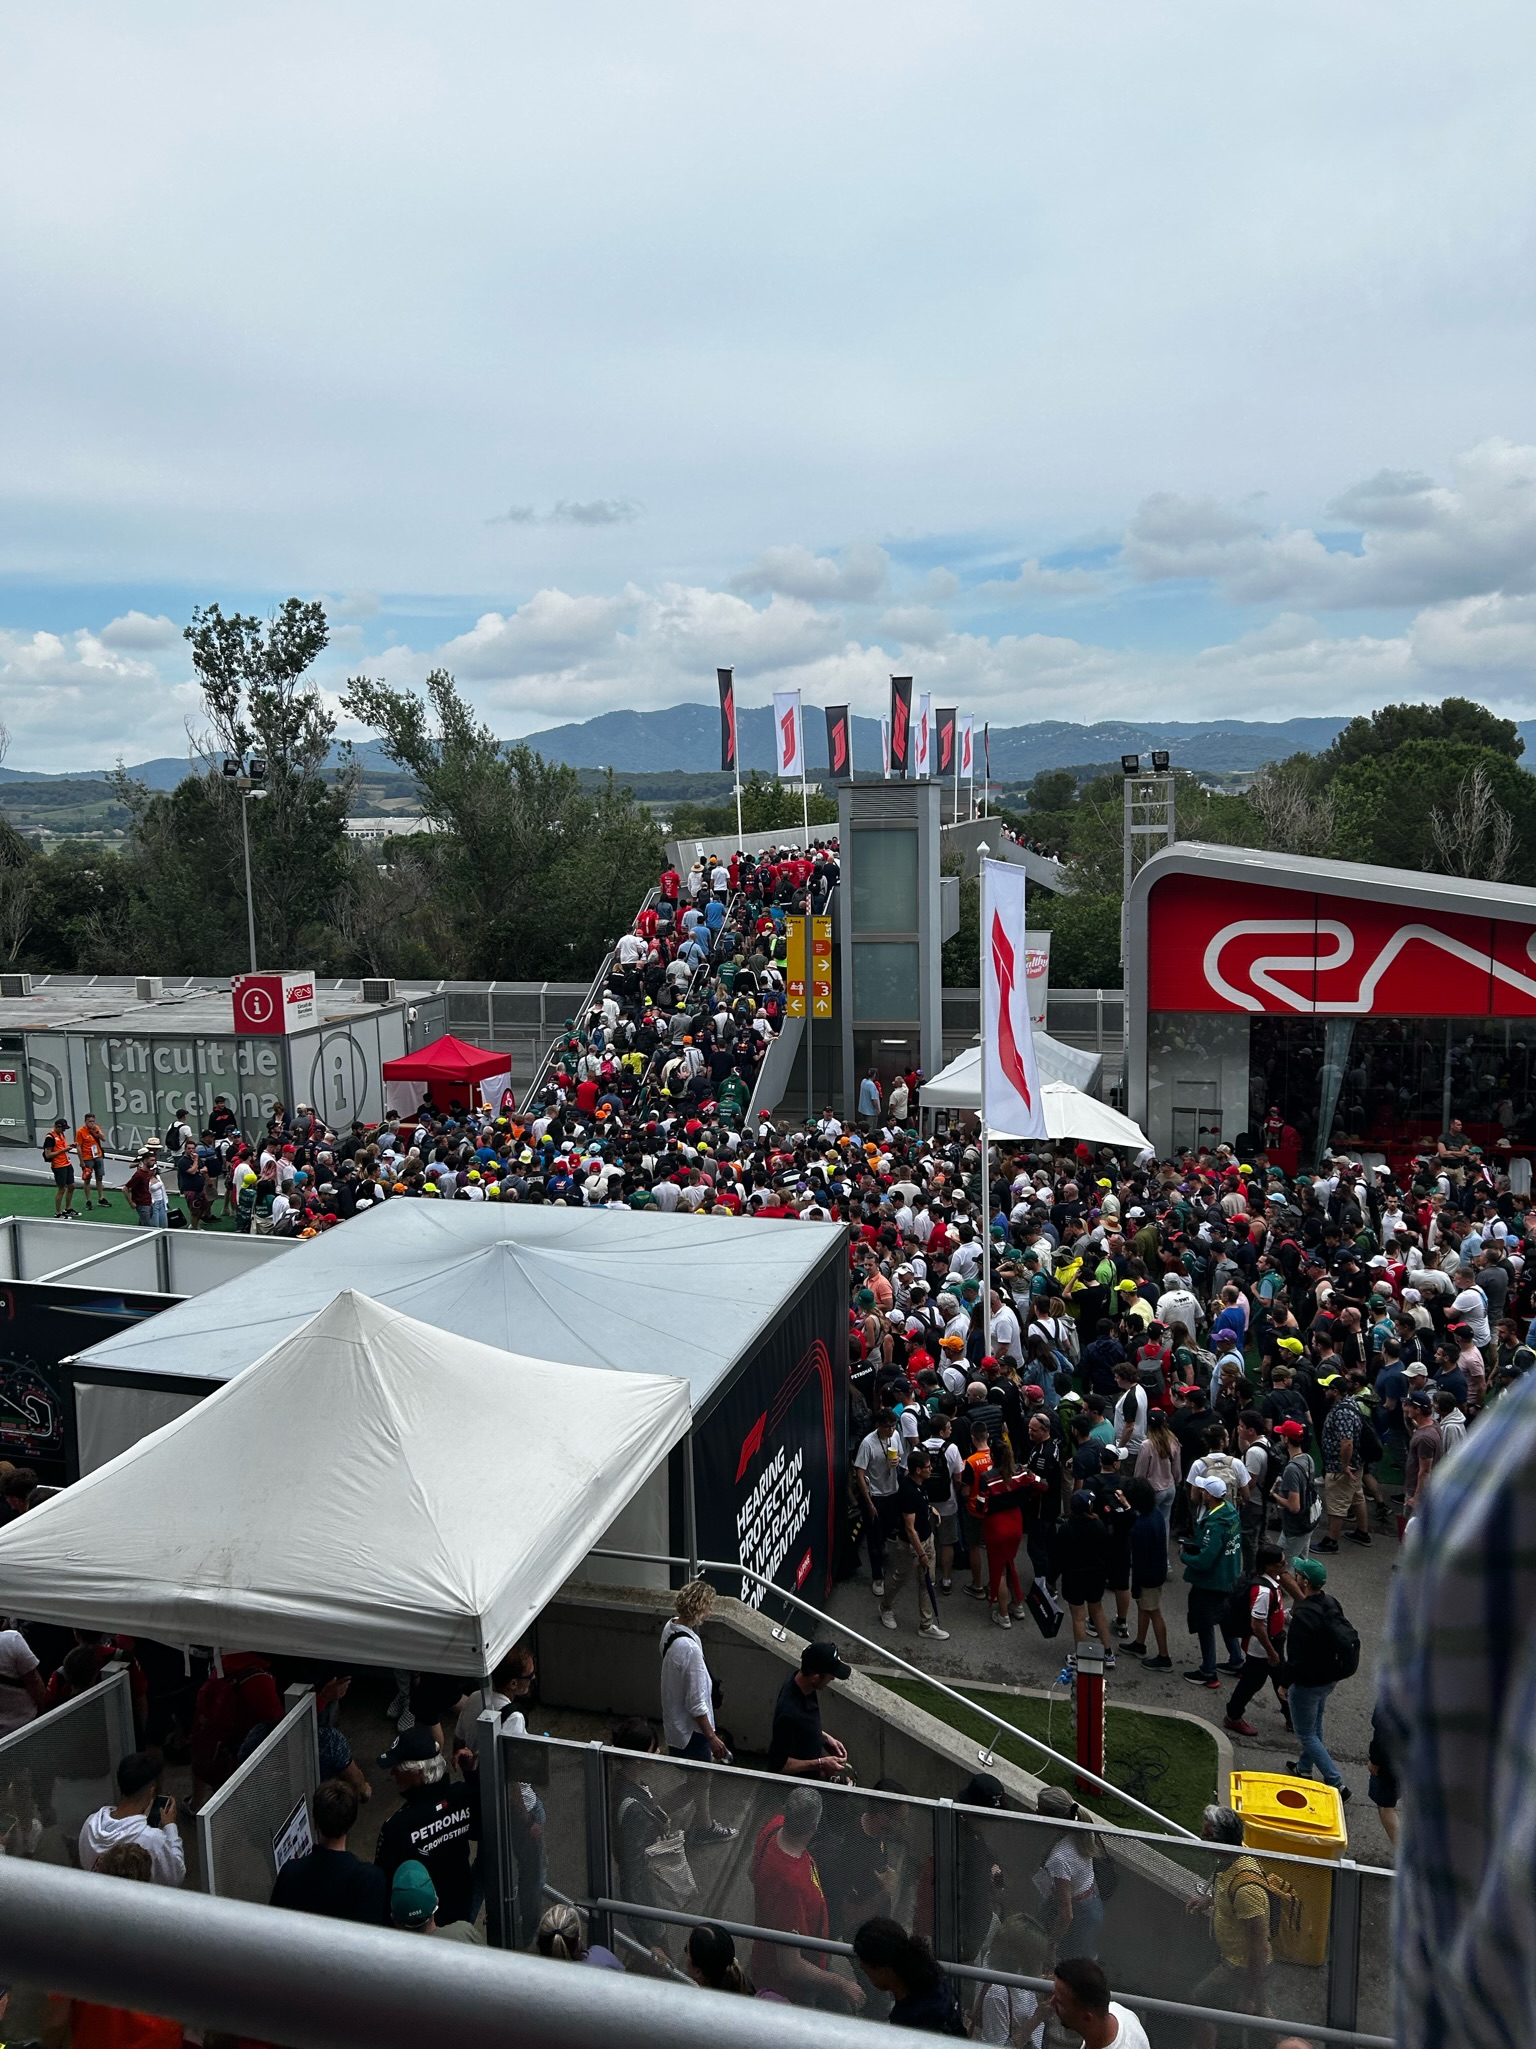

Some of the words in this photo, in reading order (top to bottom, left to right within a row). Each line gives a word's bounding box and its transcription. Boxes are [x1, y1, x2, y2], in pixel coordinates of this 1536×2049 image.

[821, 986, 829, 996] 3
[101, 1038, 225, 1075] Circuit
[233, 1040, 278, 1077] de
[104, 1081, 279, 1119] Barcelona
[737, 1445, 785, 1539] HEARING
[739, 1447, 803, 1566] PROTECTION
[741, 1575, 750, 1601] &
[750, 1528, 772, 1586] LIVE
[771, 1478, 803, 1544] RADIO
[746, 1490, 811, 1611] OMMENTARY
[410, 1807, 470, 1843] PETRONAS
[423, 1824, 470, 1852] CROWDSTRIKE
